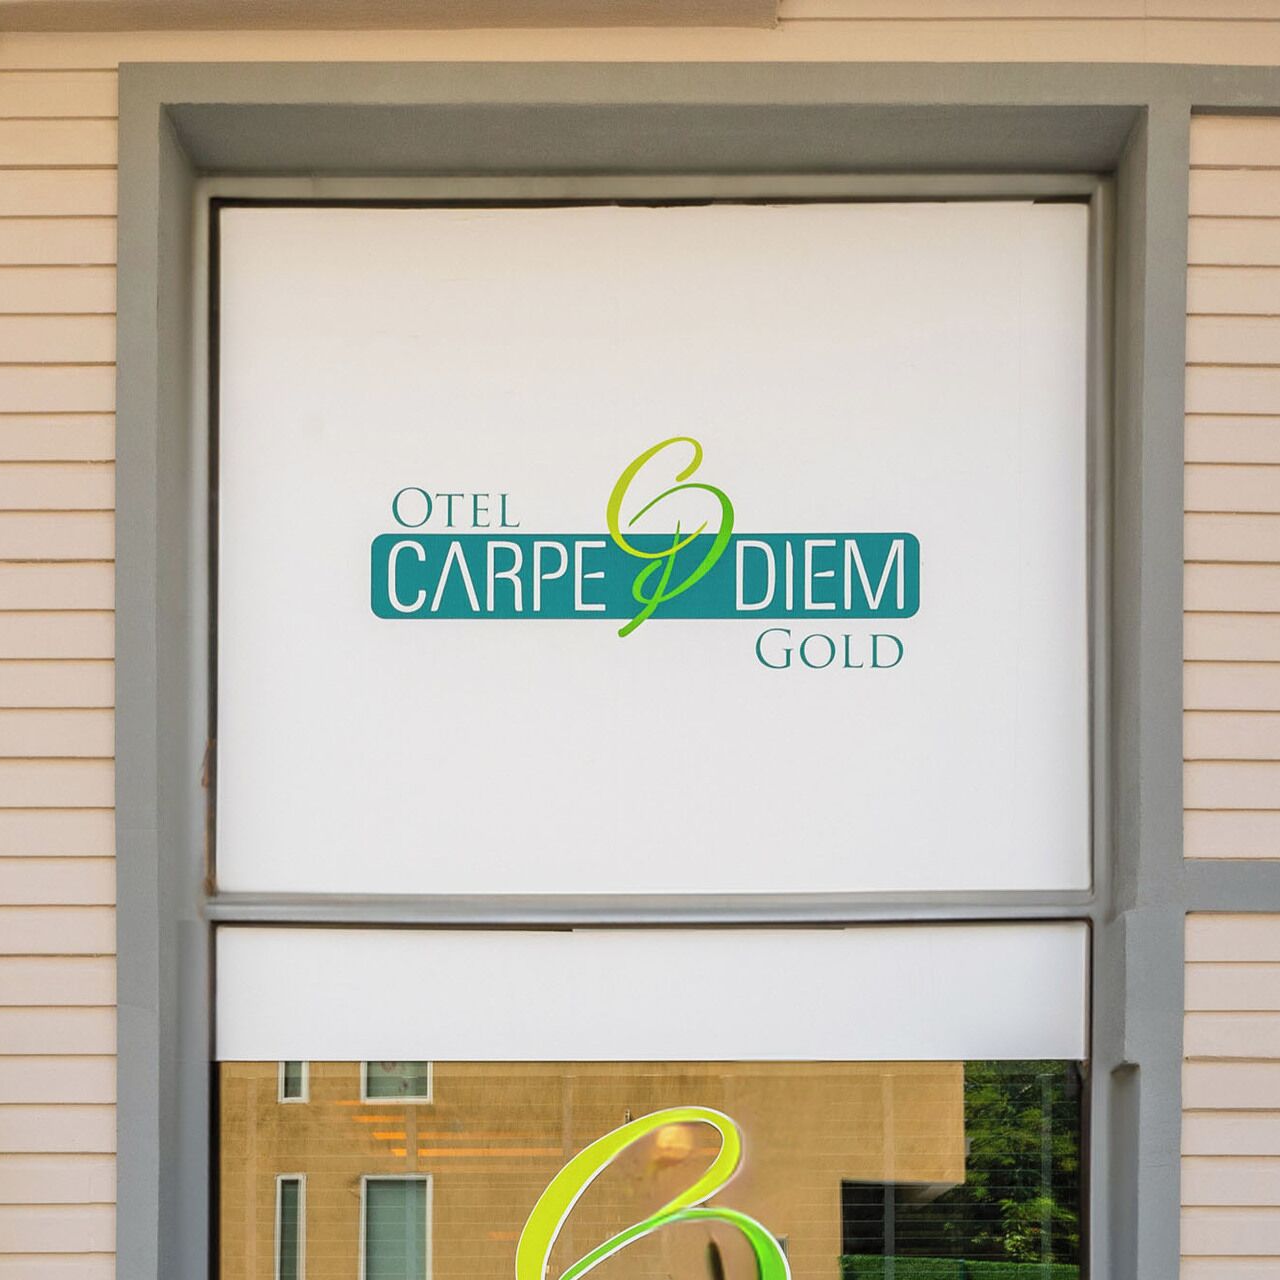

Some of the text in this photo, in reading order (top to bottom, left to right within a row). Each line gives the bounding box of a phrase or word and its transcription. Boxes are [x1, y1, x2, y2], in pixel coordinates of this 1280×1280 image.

[387, 539, 905, 613] CARPE DIEM
[755, 627, 905, 670] GOLD
